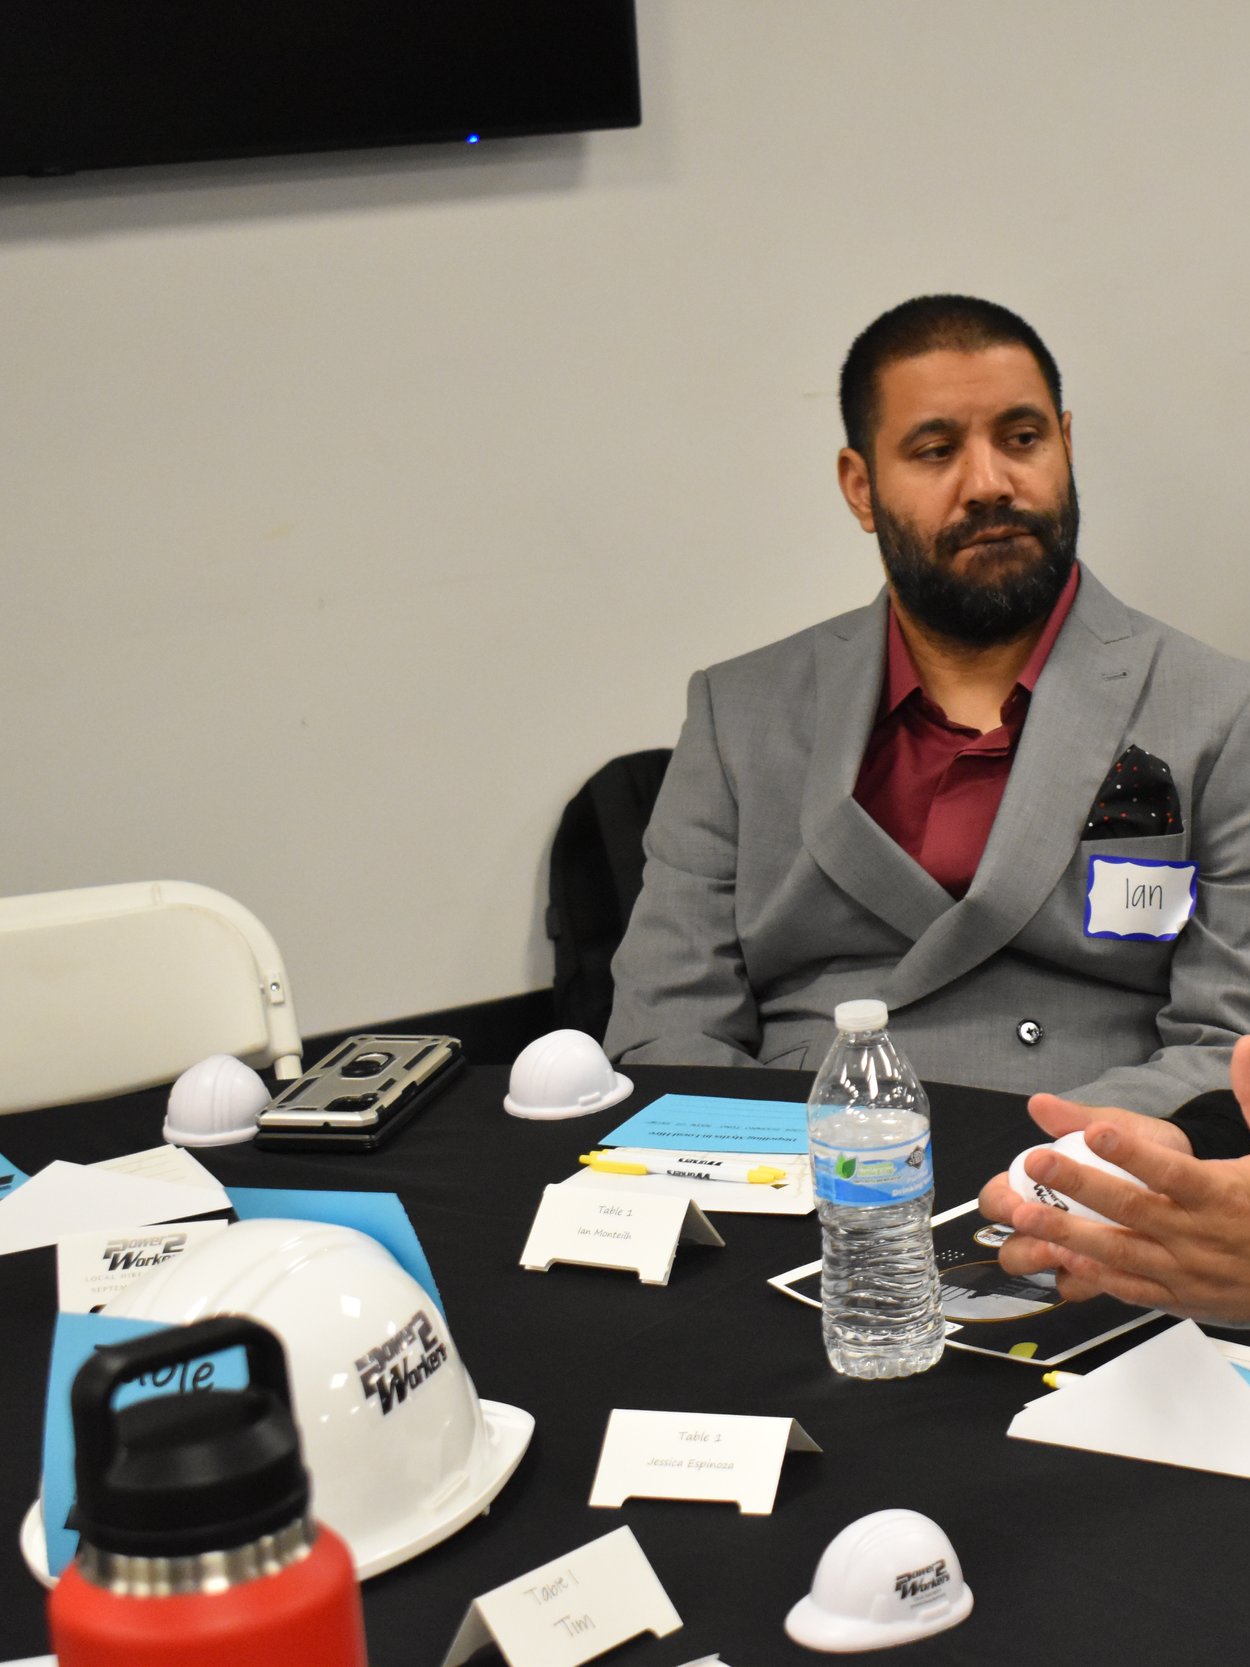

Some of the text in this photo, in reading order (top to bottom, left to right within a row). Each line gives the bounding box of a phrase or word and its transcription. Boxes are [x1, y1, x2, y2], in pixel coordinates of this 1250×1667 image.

[1125, 877, 1163, 910] Ian
[599, 1205, 633, 1217] Table 1
[577, 1226, 591, 1236] Ian
[679, 1431, 722, 1442] Table 1
[647, 1457, 735, 1471] Jessica Espinoza
[553, 1614, 596, 1637] Tim
